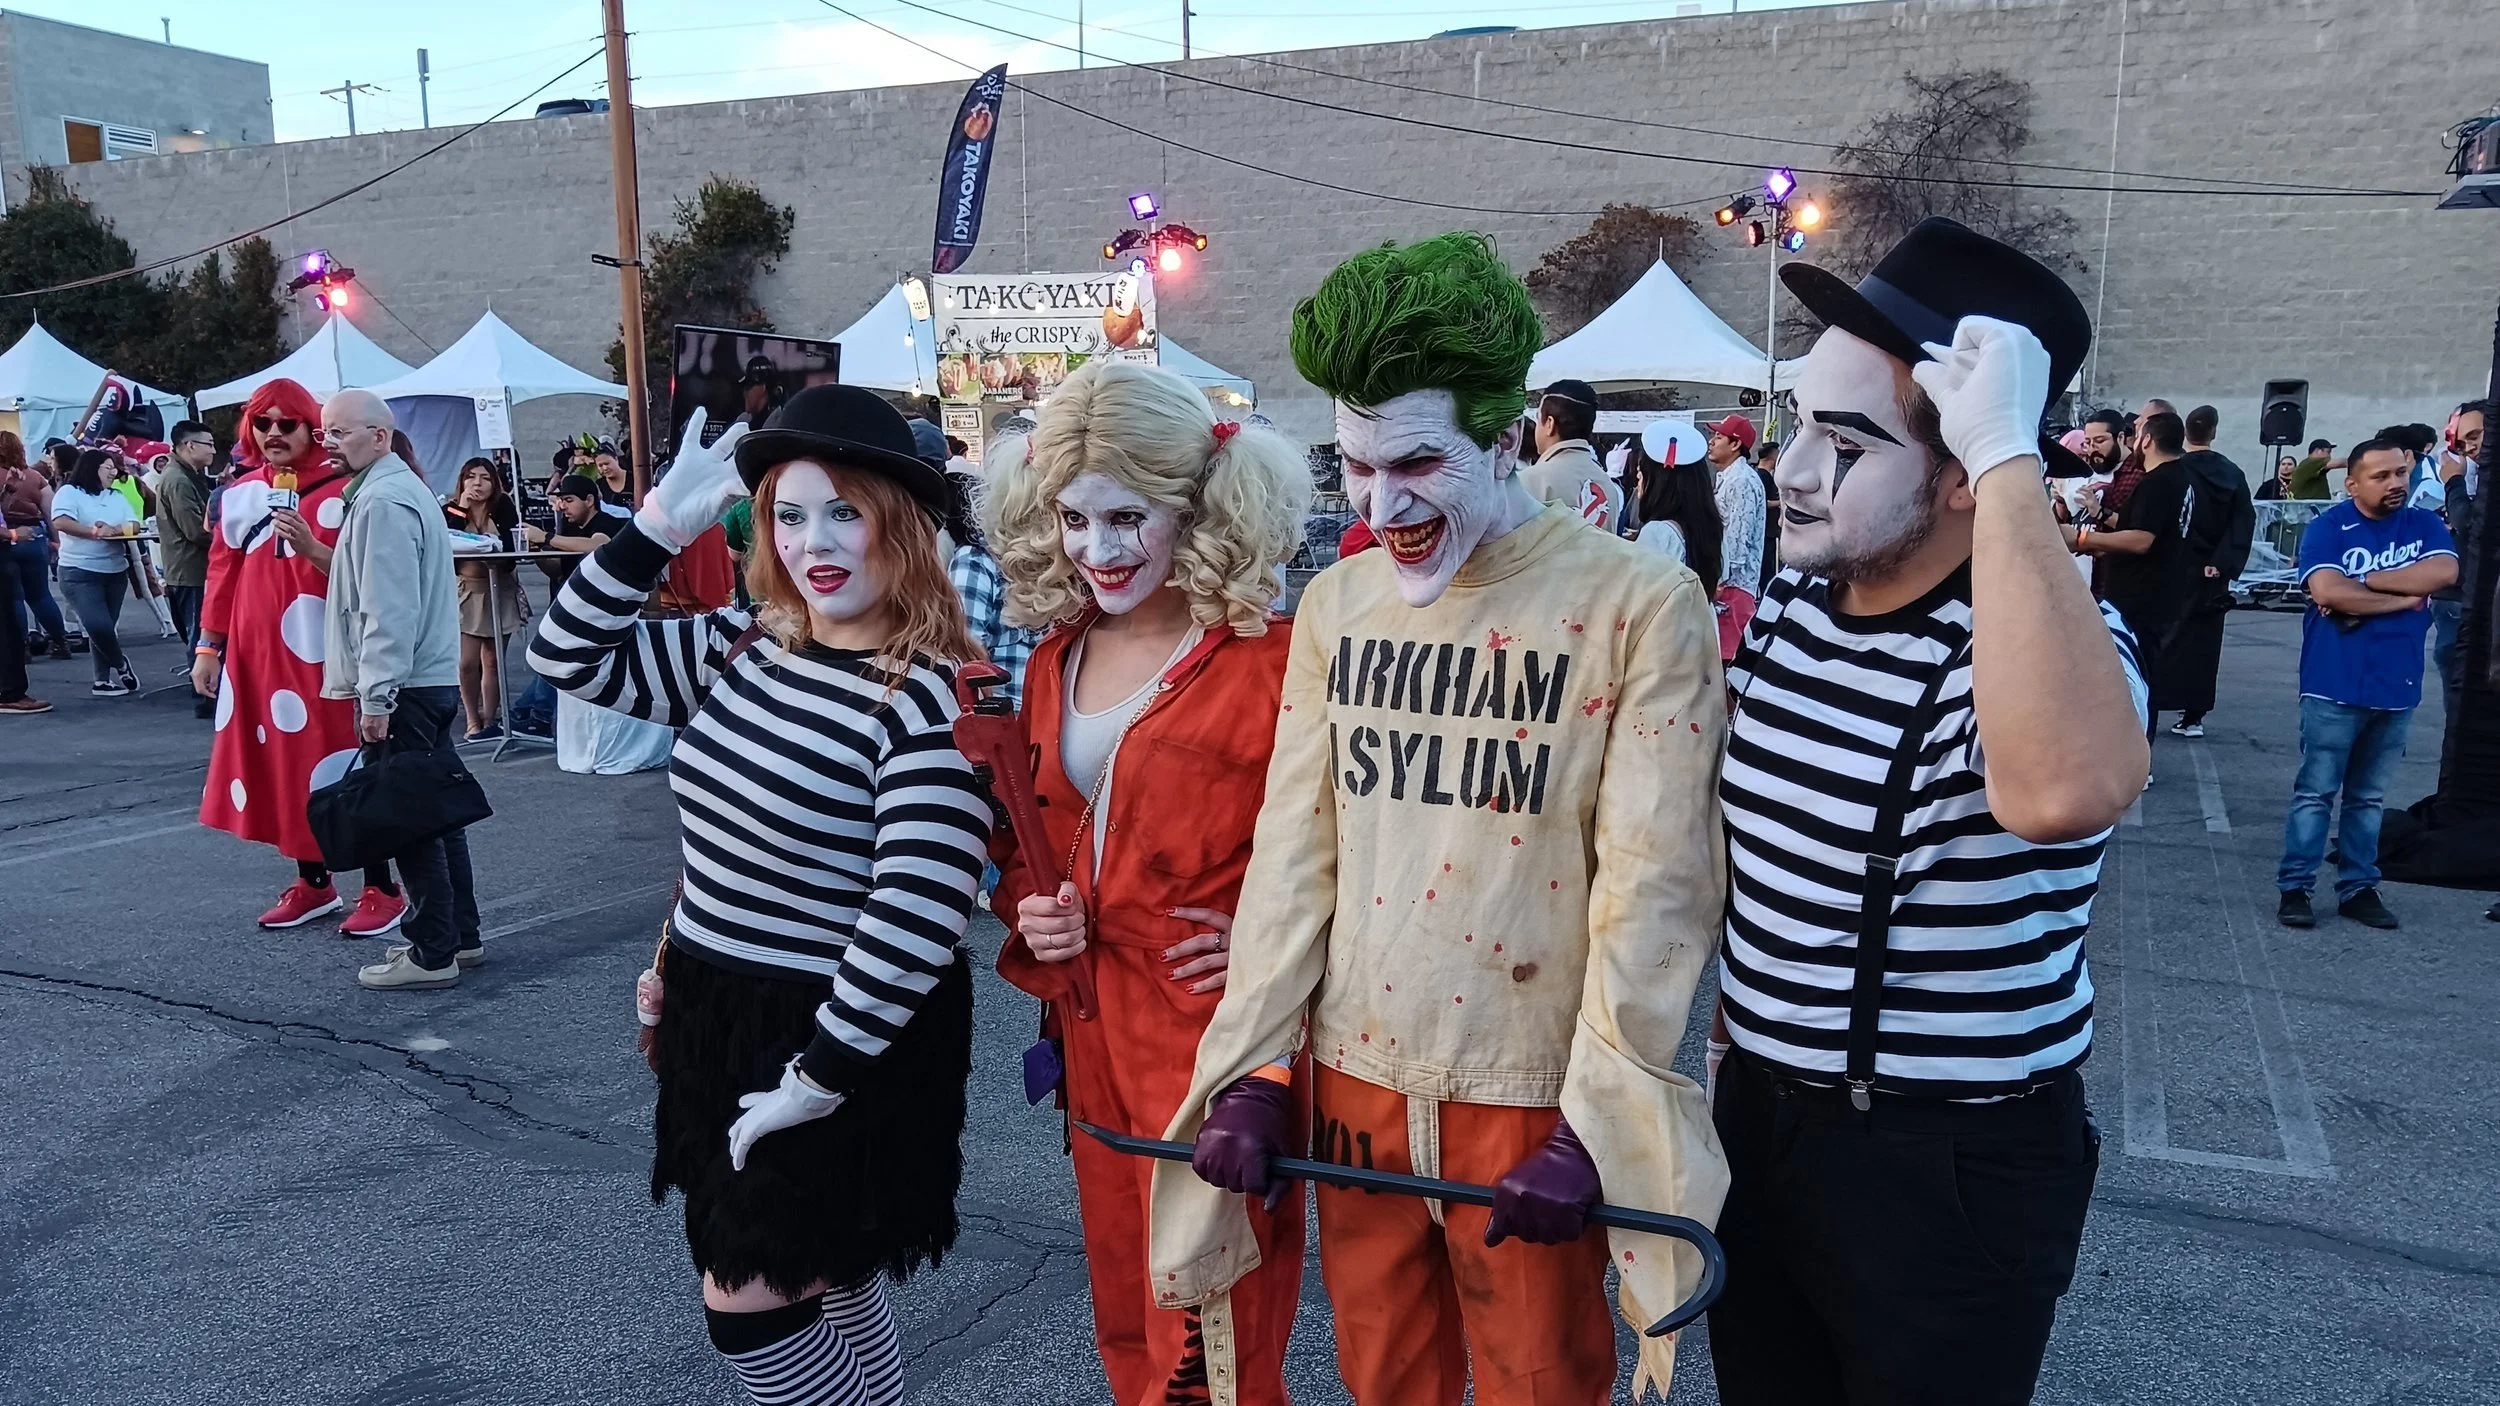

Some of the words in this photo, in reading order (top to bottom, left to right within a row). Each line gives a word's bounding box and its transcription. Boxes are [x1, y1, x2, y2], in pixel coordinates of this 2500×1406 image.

[953, 142, 981, 239] TAKOYAKI
[990, 326, 1012, 343] the
[1015, 327, 1081, 343] CRISPY
[1327, 637, 1570, 723] ARKHAM
